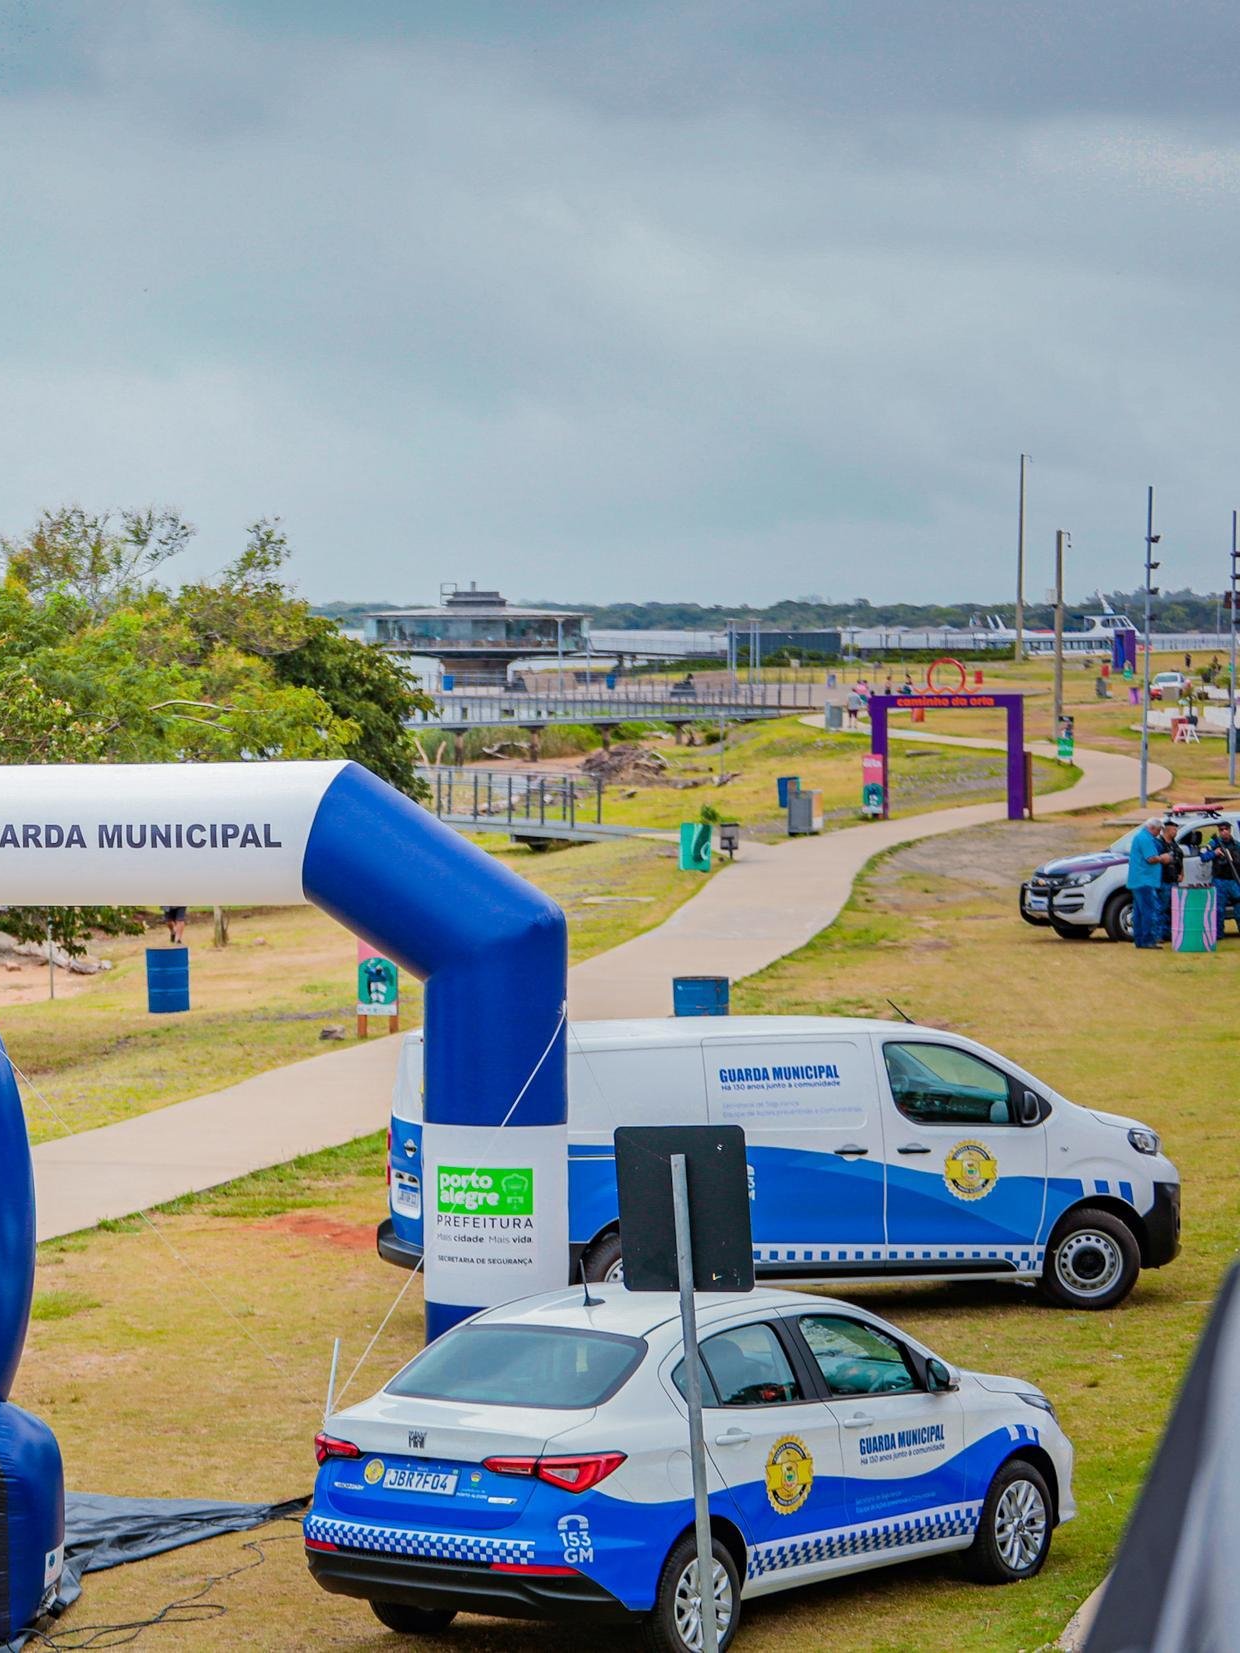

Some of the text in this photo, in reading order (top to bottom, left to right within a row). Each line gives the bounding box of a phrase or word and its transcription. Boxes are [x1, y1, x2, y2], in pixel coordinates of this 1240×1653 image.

[897, 696, 949, 706] caminho
[952, 696, 967, 706] da
[98, 823, 282, 849] MUNICIPAL
[719, 1064, 840, 1083] GUARDA MUNICIPAL
[766, 1082, 786, 1091] junto
[794, 1079, 840, 1088] comunidade
[439, 1171, 493, 1190] porto
[440, 1188, 500, 1210] alegre
[436, 1215, 533, 1229] PREFEITURA
[488, 1235, 511, 1244] Mais
[438, 1254, 533, 1266] SECRETARIA DE SEGURANÇA
[859, 1424, 944, 1456] GUARDA MUNICIPAL
[389, 1471, 448, 1491] JBR7F04
[560, 1531, 592, 1547] 153
[563, 1548, 594, 1564] GM
